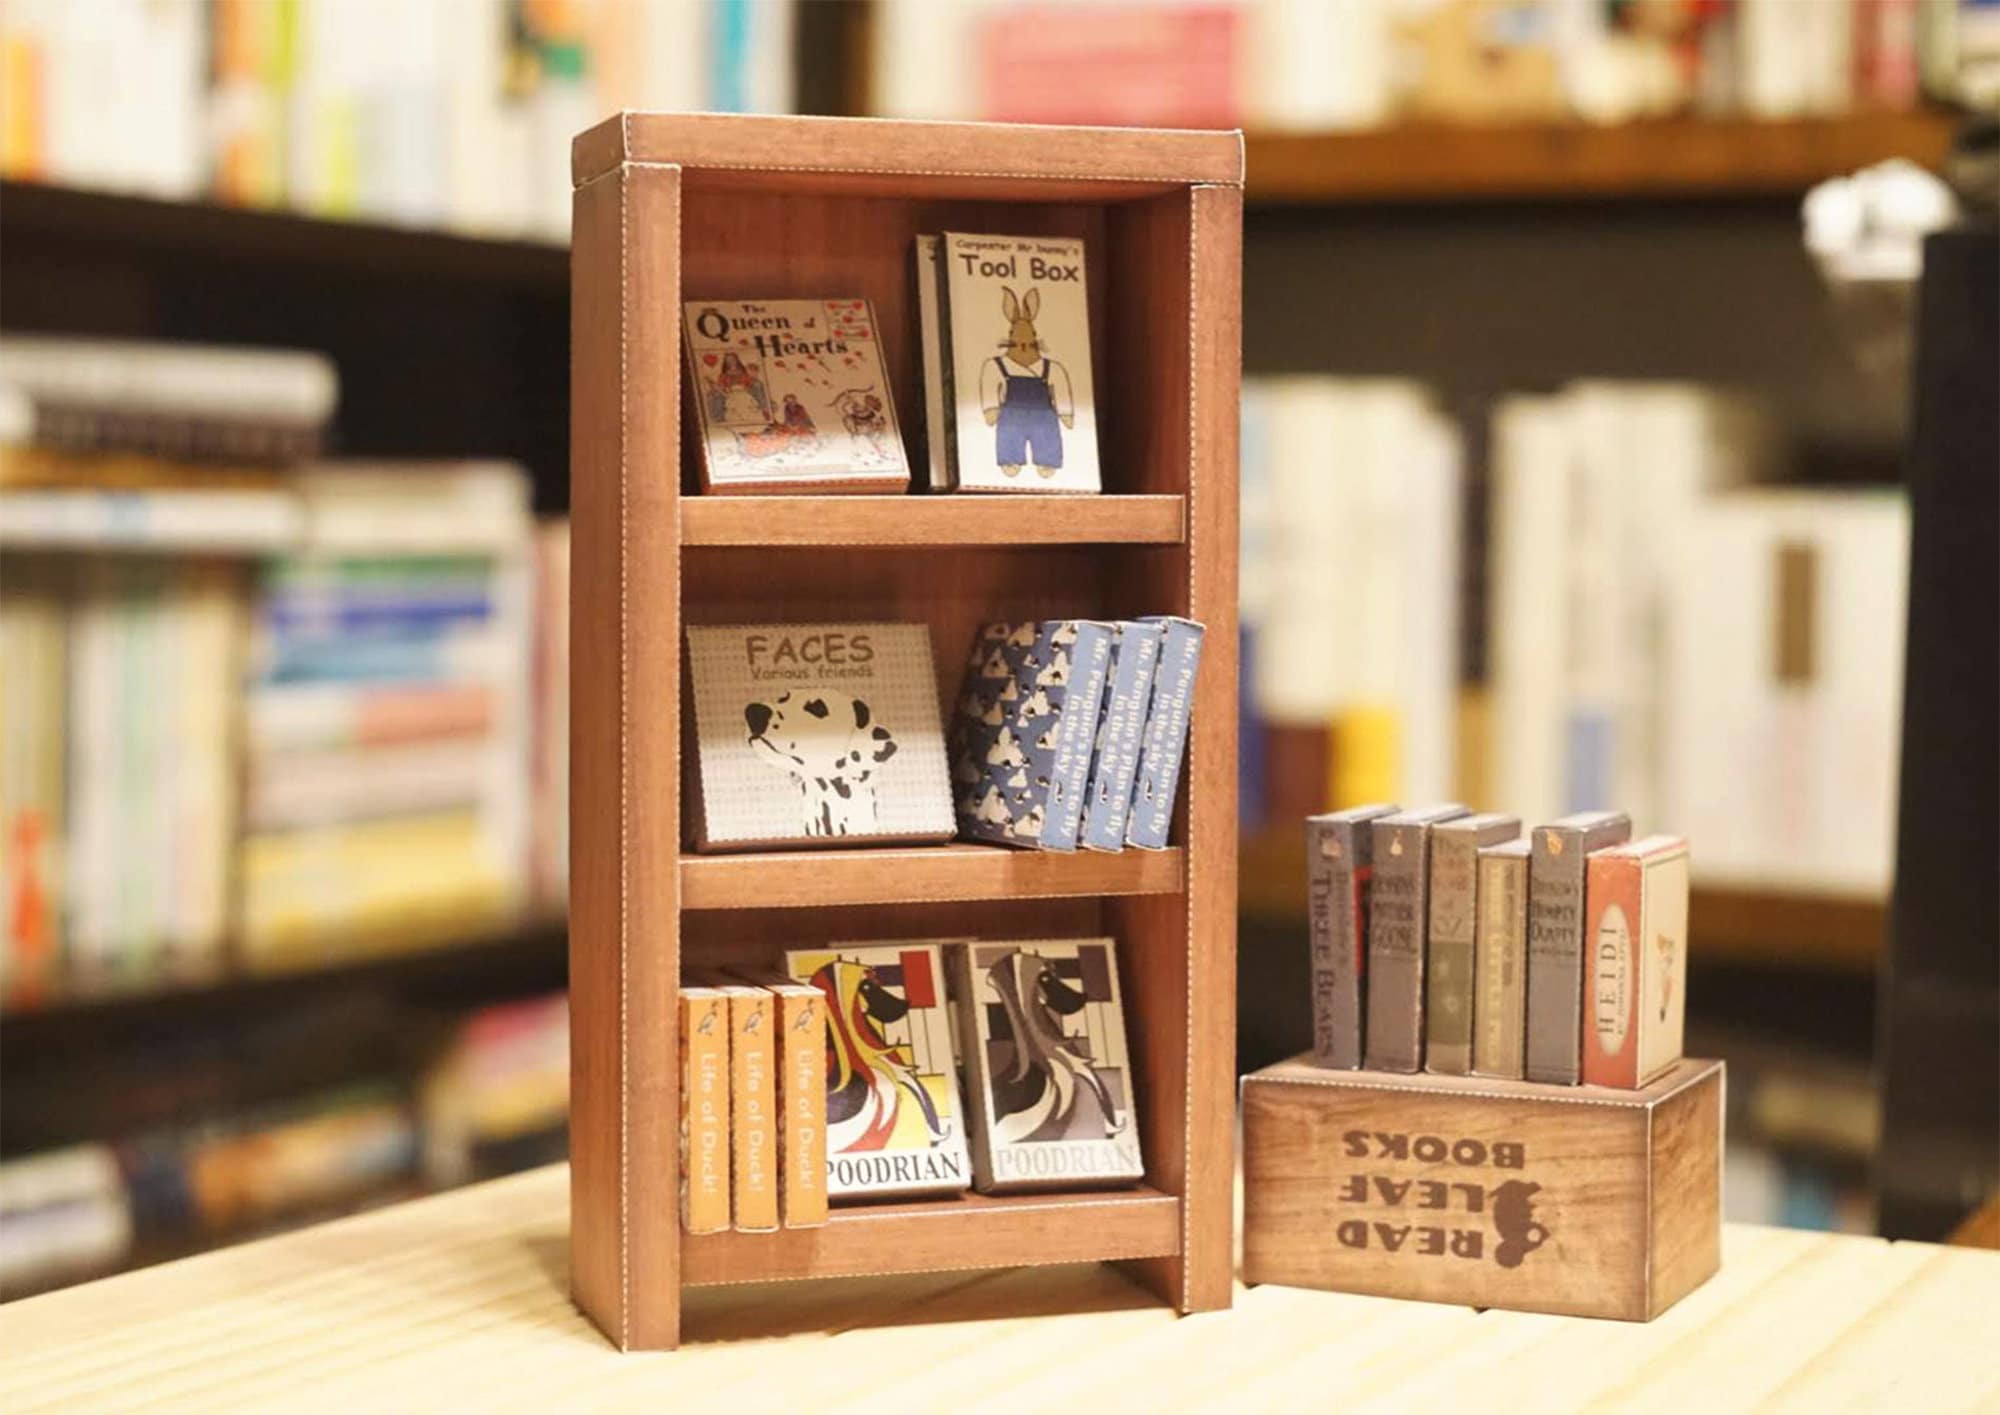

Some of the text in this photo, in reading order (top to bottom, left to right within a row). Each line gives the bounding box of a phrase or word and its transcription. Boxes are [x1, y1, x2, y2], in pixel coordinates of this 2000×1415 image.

[959, 254, 1079, 282] Tool Box
[742, 305, 765, 313] The
[697, 308, 791, 341] Queen
[754, 335, 848, 357] Hearts
[746, 634, 874, 664] FACES
[751, 664, 873, 680] Various friends
[1061, 637, 1107, 838] Mr. Penguin's Plan to fly
[1064, 715, 1078, 741] the
[1106, 638, 1153, 838] Mr. Penguin's Plan to fly
[1110, 715, 1124, 741] the
[1150, 637, 1198, 836] Mr. Penguin's Plan to fly
[1154, 713, 1168, 741] the
[1056, 746, 1073, 774] sky
[1102, 746, 1118, 774] sky
[1148, 745, 1163, 773] sky
[1312, 871, 1332, 961] THREE
[1598, 928, 1618, 1034] HEIDI
[701, 1053, 717, 1093] Life
[747, 1052, 763, 1092] Life
[798, 1050, 814, 1091] Life
[702, 1101, 718, 1123] of
[748, 1099, 764, 1121] of
[800, 1096, 814, 1119] of
[999, 1144, 1136, 1177] POODRIAN
[1342, 1130, 1525, 1170] BOOKS
[1337, 1175, 1484, 1213] LEAF
[1337, 1220, 1483, 1259] READ
